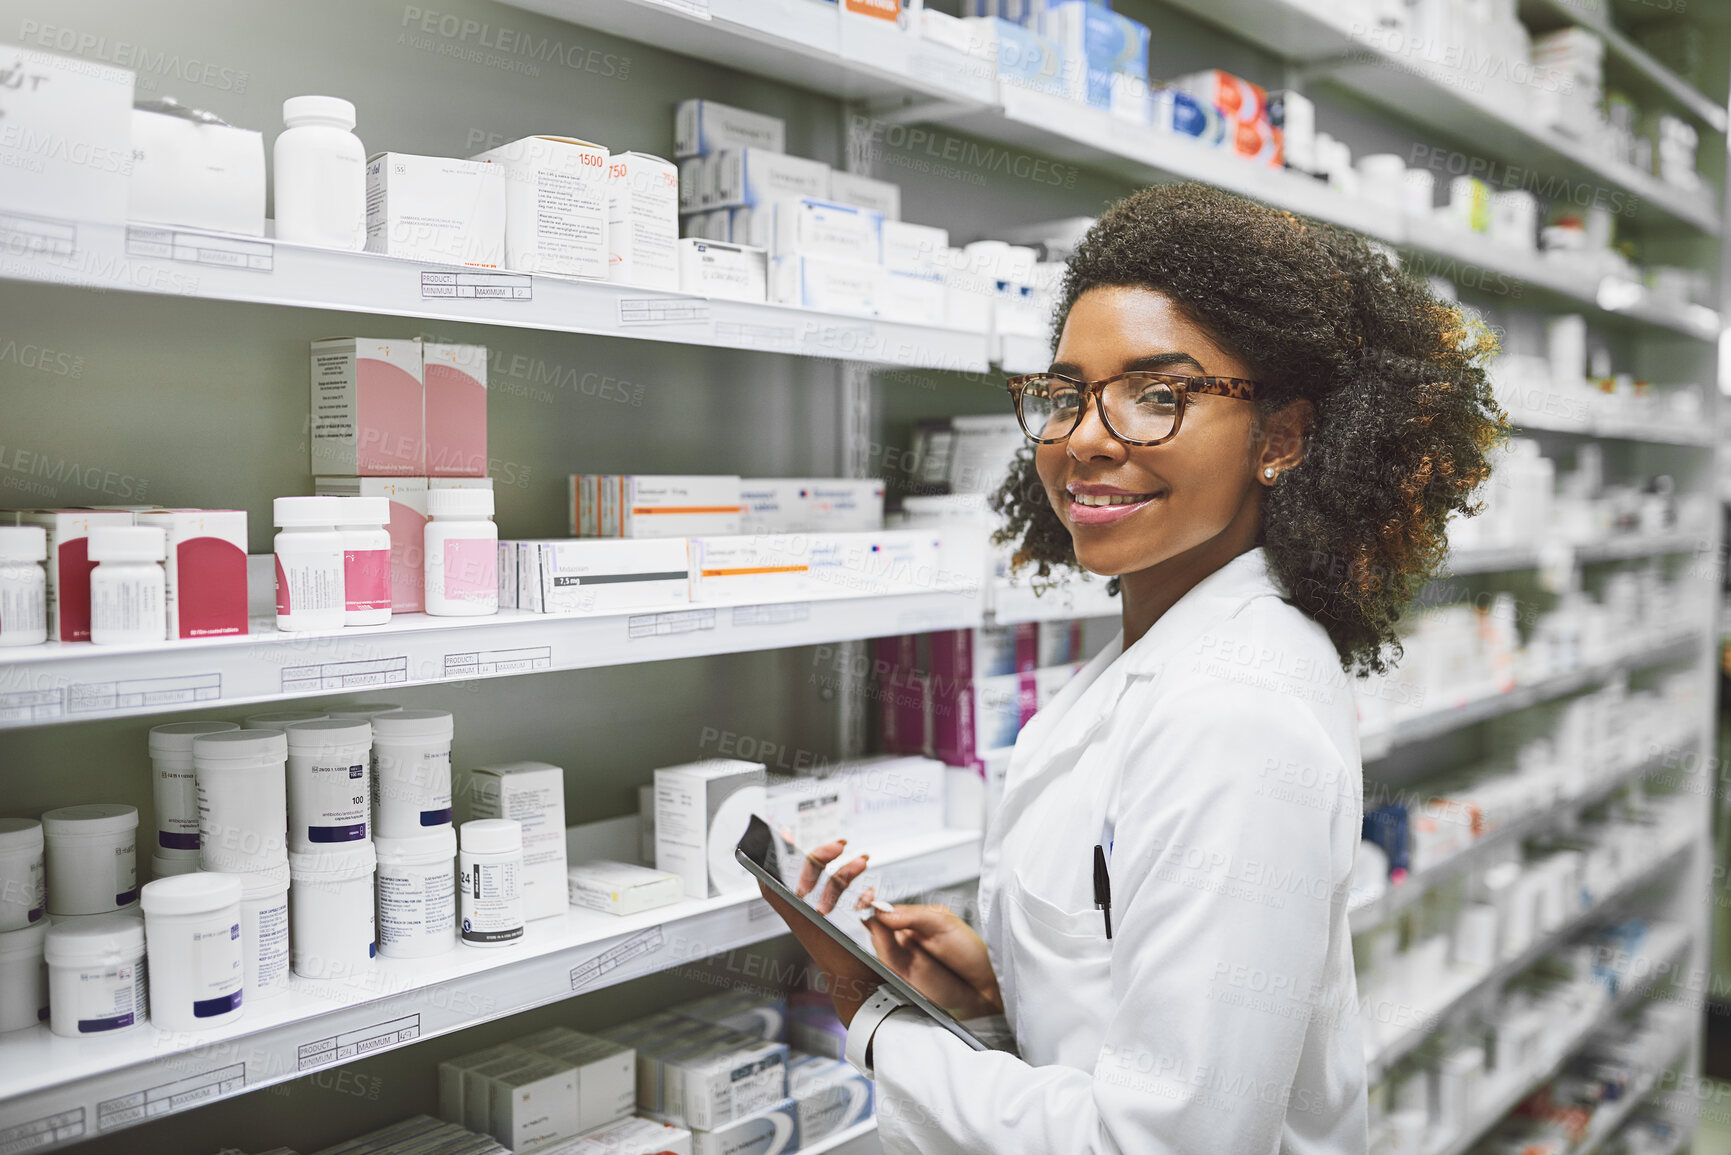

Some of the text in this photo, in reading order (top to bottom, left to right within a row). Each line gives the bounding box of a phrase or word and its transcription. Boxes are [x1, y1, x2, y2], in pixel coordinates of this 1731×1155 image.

[578, 153, 603, 168] 1500
[608, 163, 627, 179] 750
[423, 275, 452, 283] PRODUCT:
[423, 286, 453, 294] MINIMUM
[476, 288, 506, 296] MAXIMUM
[570, 578, 581, 586] mg
[445, 656, 475, 665] PRODUCT:
[445, 667, 475, 676] MINIMUM
[498, 661, 526, 671] MAXIMUM
[352, 795, 364, 805] 100
[461, 872, 471, 884] 24
[300, 1041, 332, 1055] PRODUCT:
[300, 1052, 333, 1068] MINIMUM
[358, 1036, 391, 1051] MAXIMUM
[172, 1089, 211, 1106] MAXIMUM
